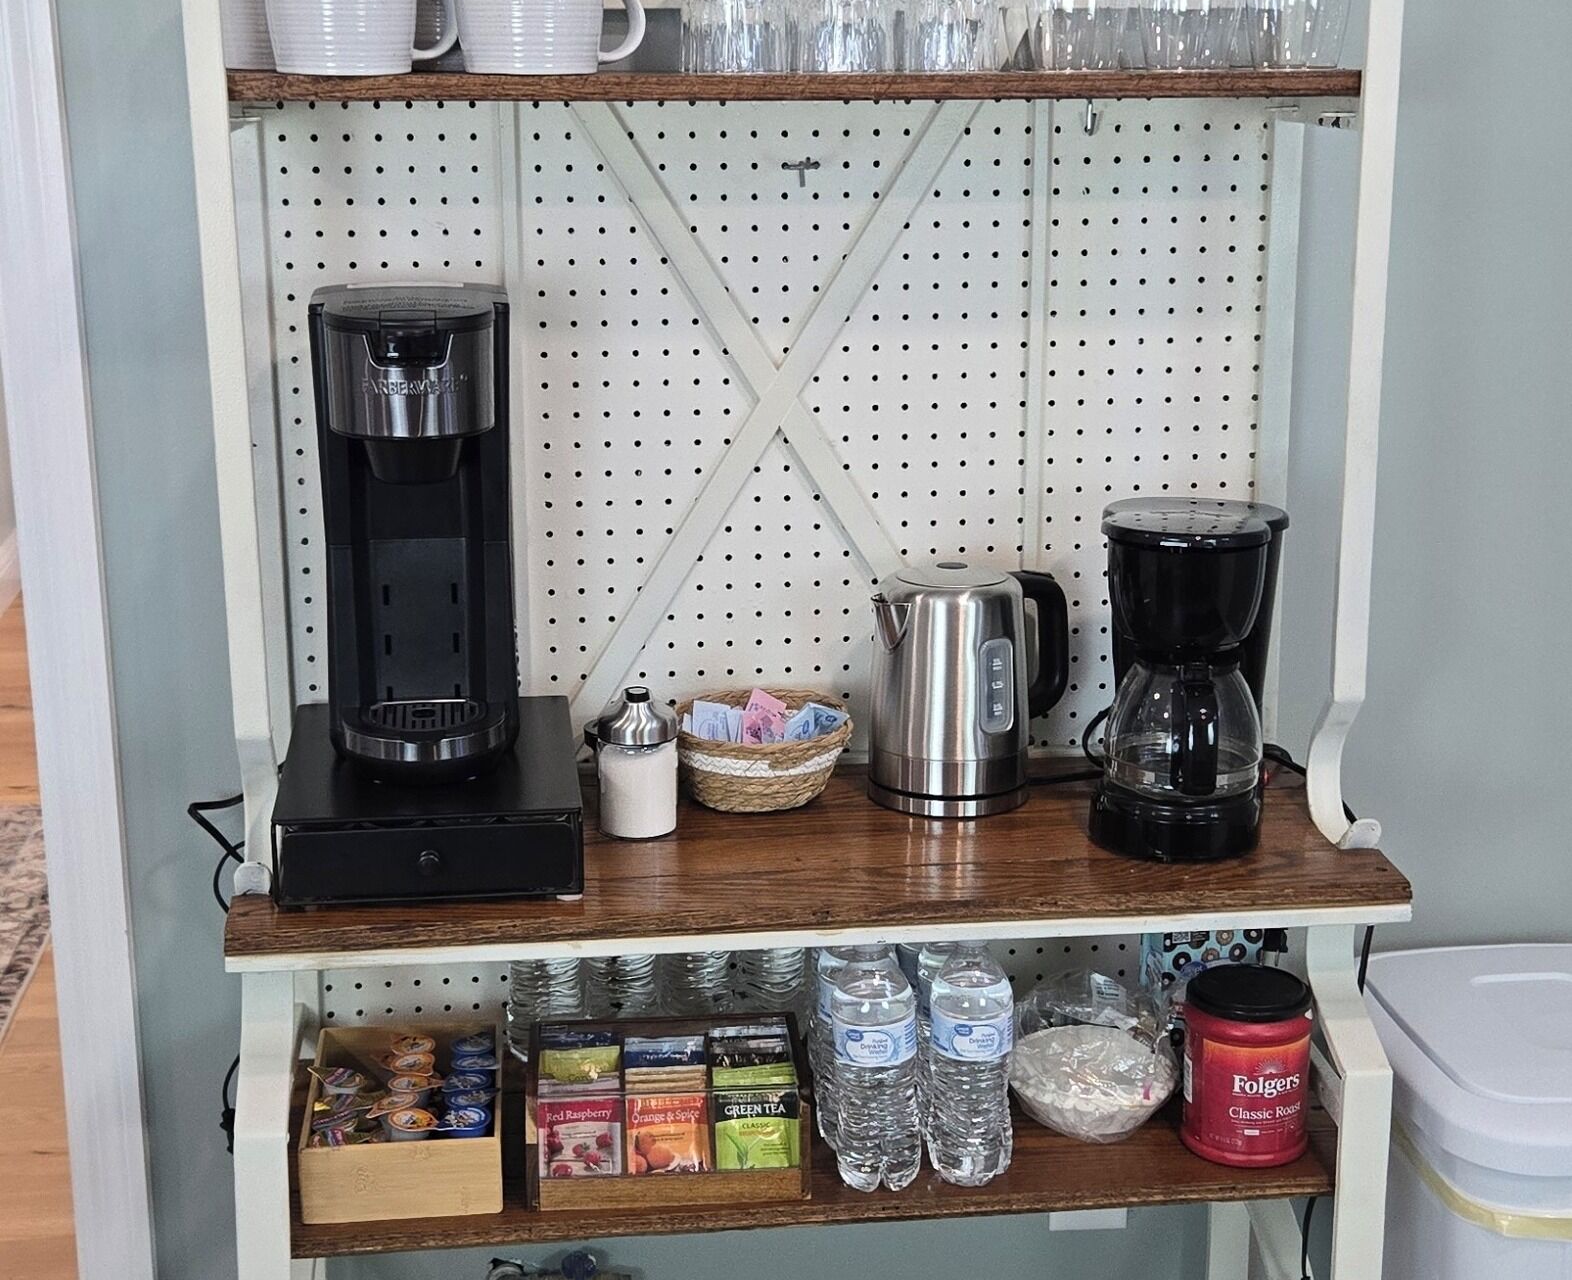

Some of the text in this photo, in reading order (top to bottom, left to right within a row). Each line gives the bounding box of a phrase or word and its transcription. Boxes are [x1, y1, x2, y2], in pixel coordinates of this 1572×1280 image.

[1232, 1074, 1300, 1098] Folgers
[546, 1109, 612, 1122] Red Raspberry
[632, 1108, 700, 1124] Orange & Spice
[724, 1103, 786, 1116] GREEN TEA
[1229, 1102, 1301, 1119] Classic Roast
